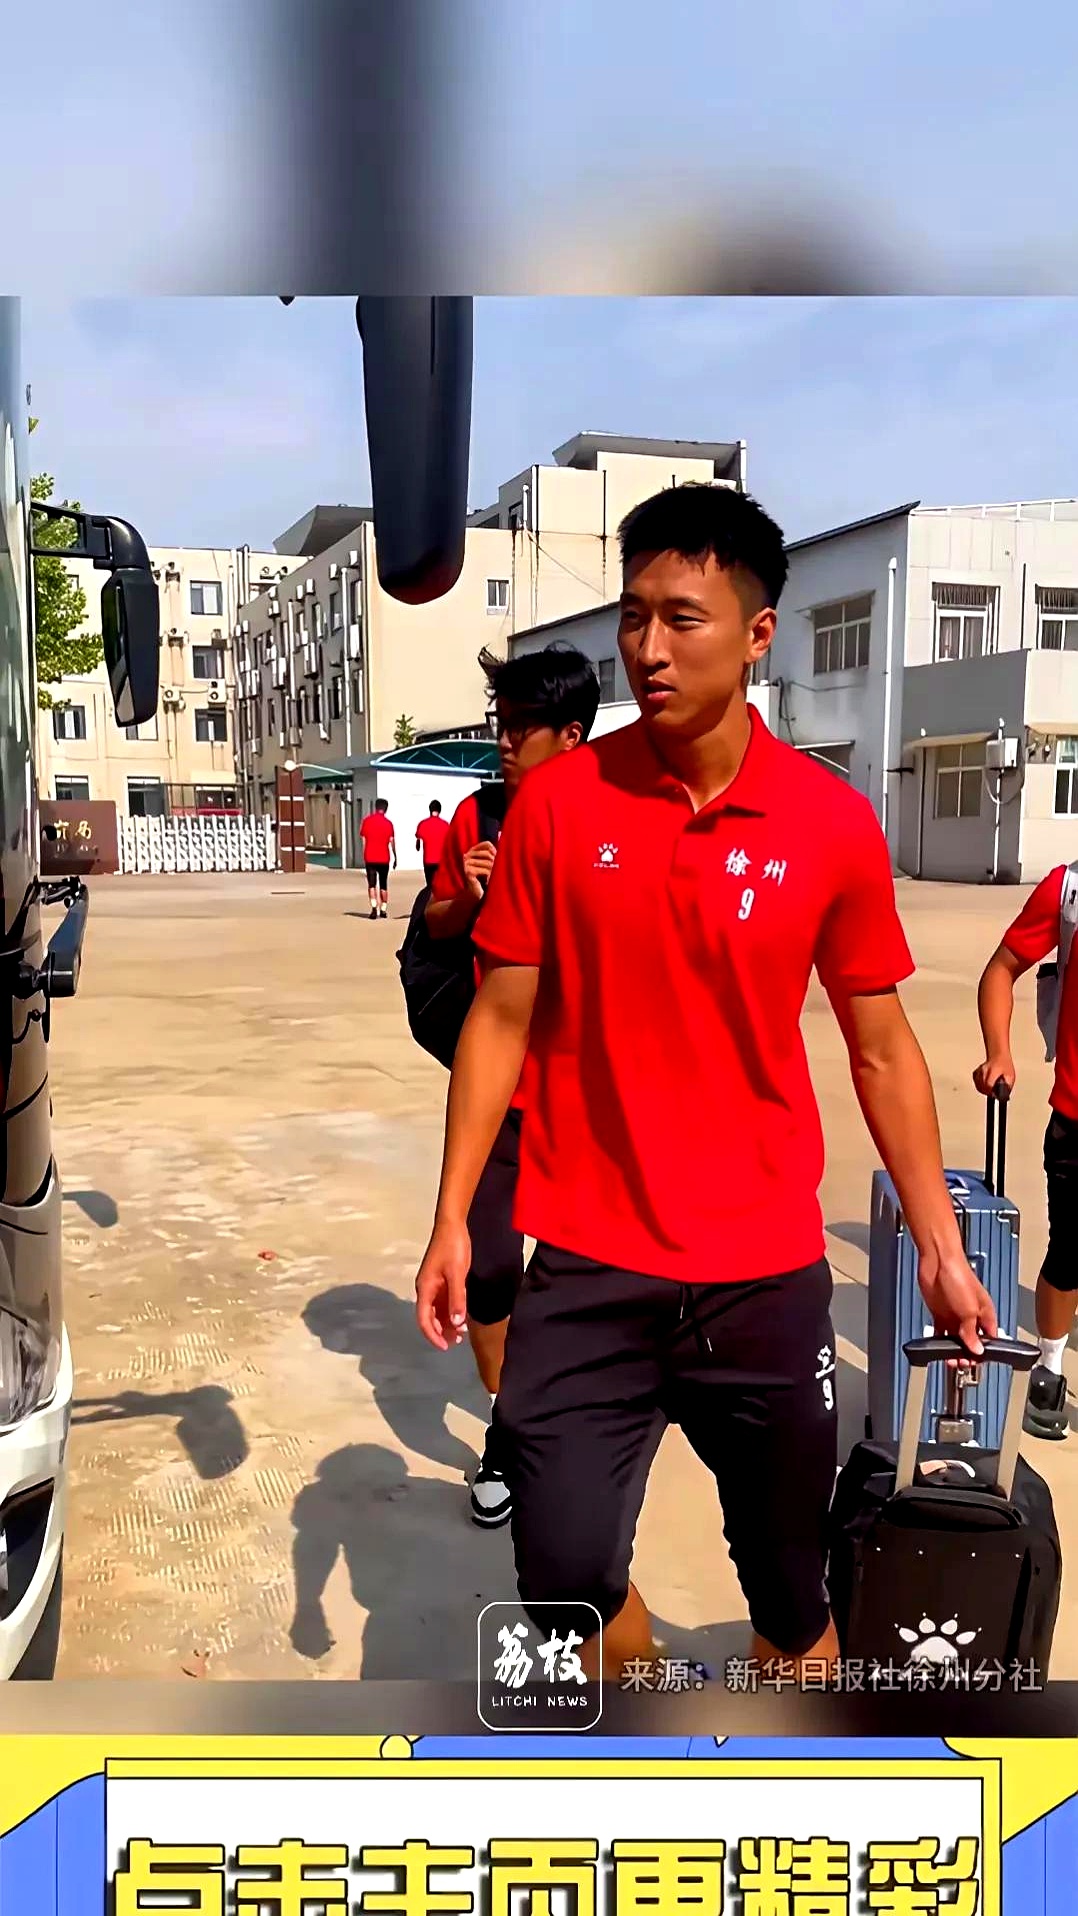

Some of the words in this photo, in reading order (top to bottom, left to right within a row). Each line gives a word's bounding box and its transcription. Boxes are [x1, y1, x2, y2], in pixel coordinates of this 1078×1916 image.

[725, 847, 788, 887] 徐州
[737, 887, 755, 921] 9
[822, 1378, 834, 1411] 9
